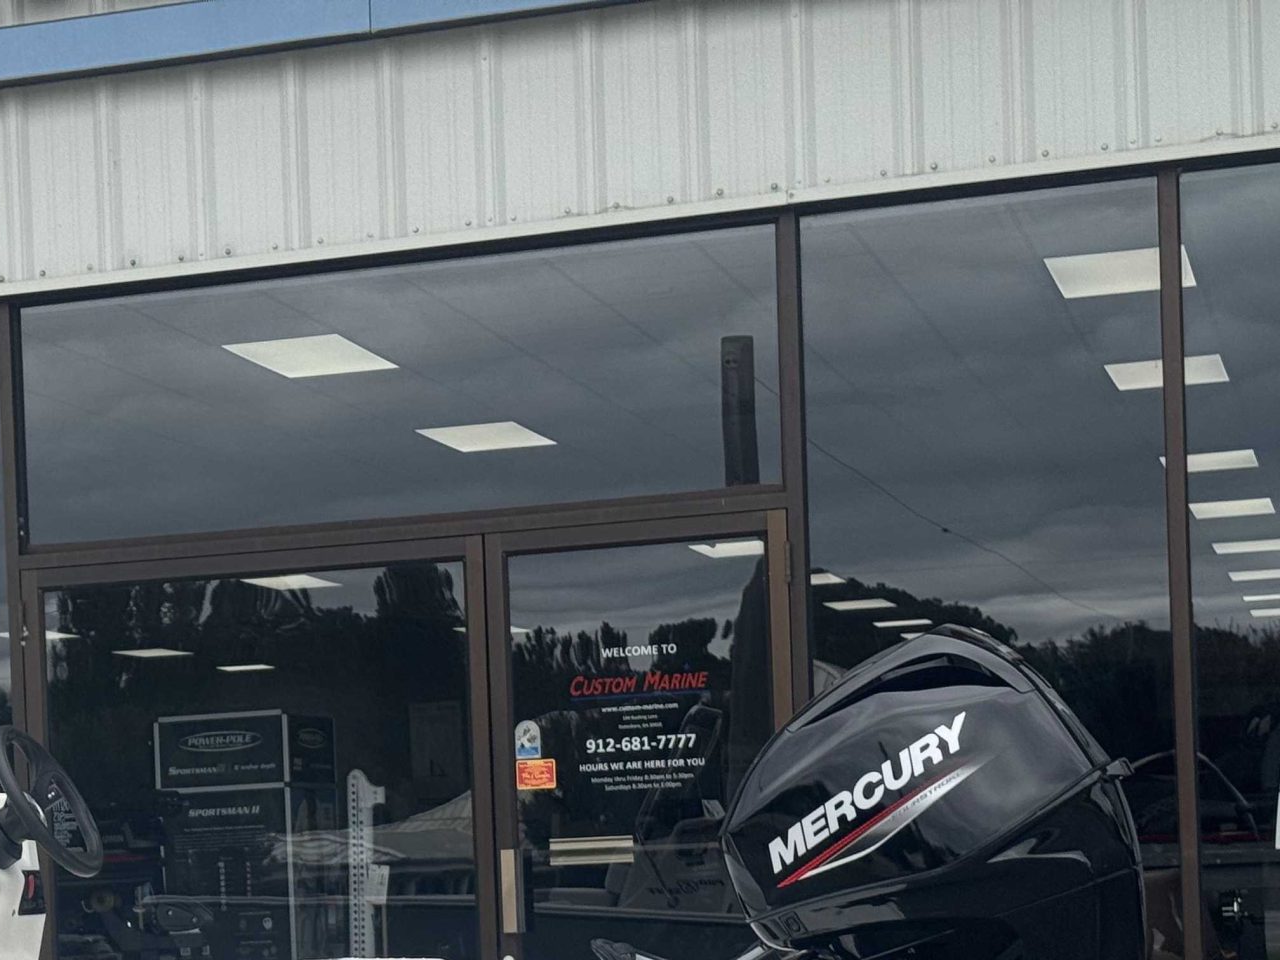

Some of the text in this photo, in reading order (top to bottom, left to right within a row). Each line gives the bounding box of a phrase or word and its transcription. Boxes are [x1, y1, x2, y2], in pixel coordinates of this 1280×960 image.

[601, 643, 677, 658] WELCOME TO
[569, 671, 709, 697] CUSTOM MARINE
[586, 733, 696, 754] 912-681-7777
[579, 757, 705, 772] HOURS WE ARE HERE FOR YOU
[768, 711, 966, 874] MERCURY
[188, 805, 250, 817] SPORTSMAN
